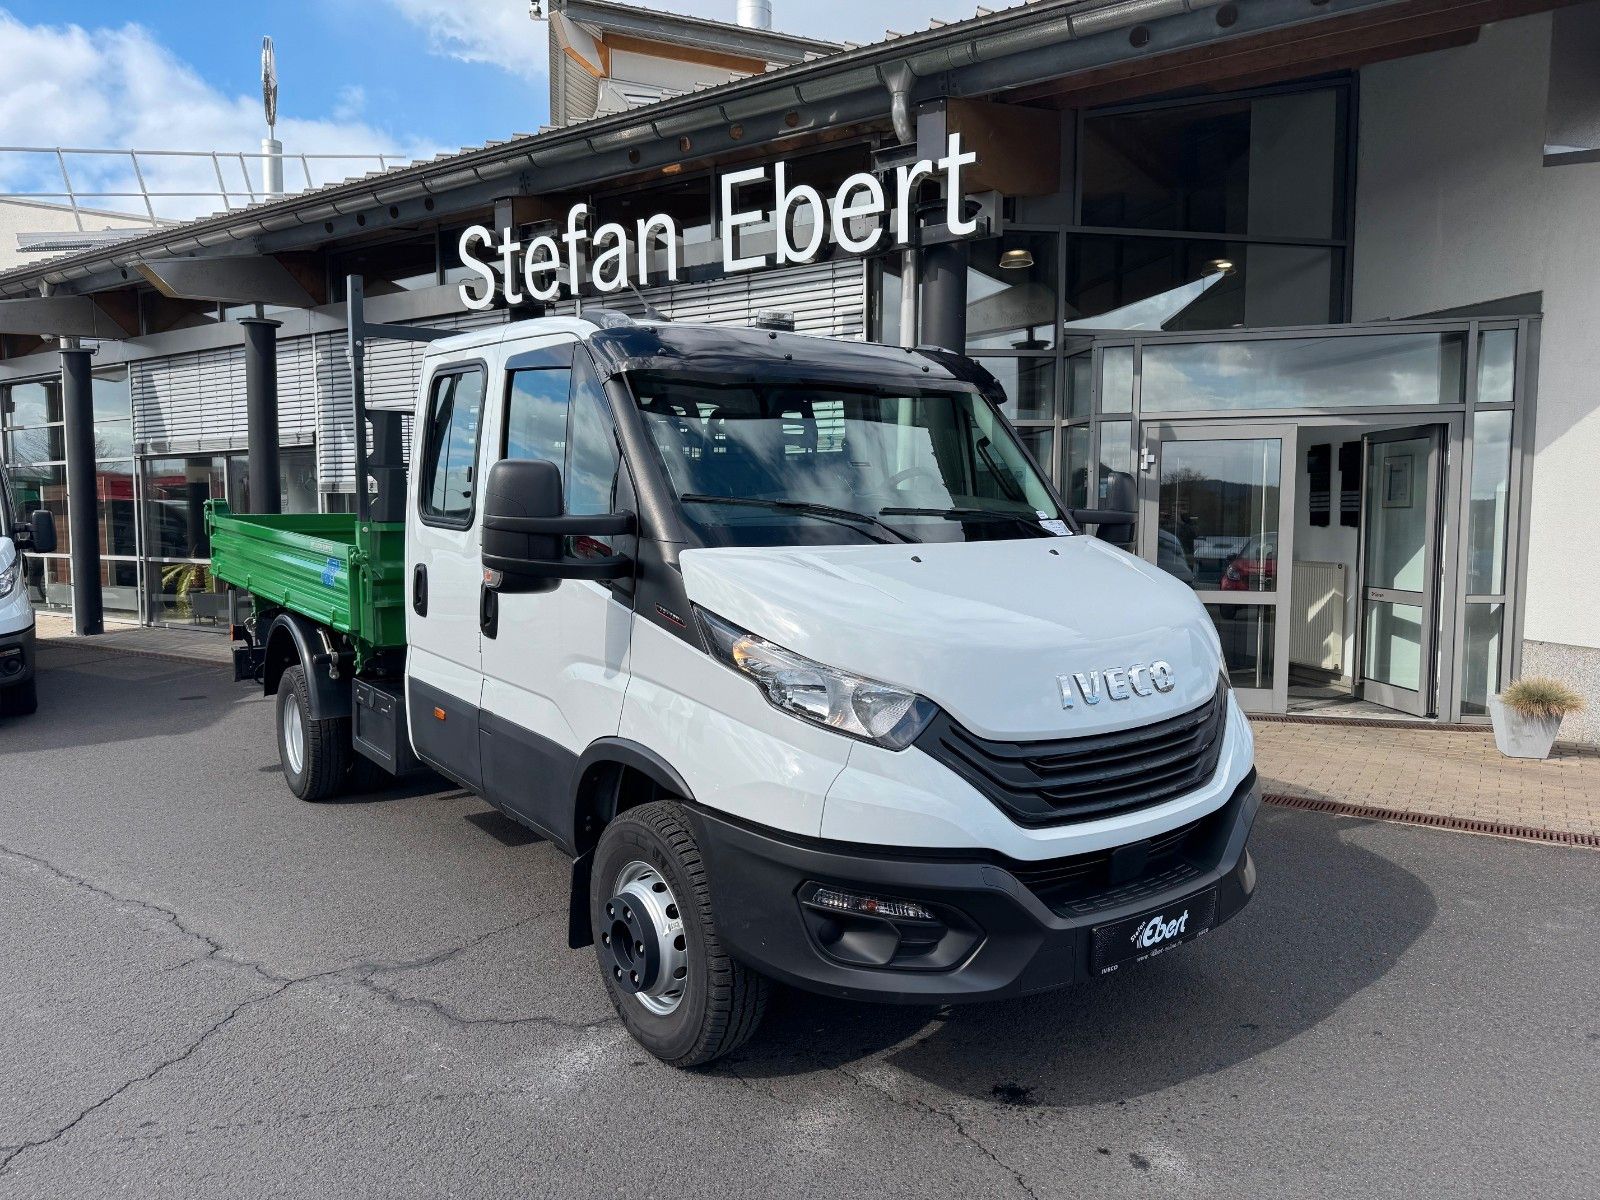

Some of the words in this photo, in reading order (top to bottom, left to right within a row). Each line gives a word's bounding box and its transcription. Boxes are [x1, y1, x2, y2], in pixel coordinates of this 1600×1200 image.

[459, 203, 677, 309] Stefan
[721, 133, 977, 272] Ebert
[1056, 660, 1176, 710] IVECO
[1142, 909, 1189, 947] Ebert
[1101, 964, 1118, 974] IVECO
